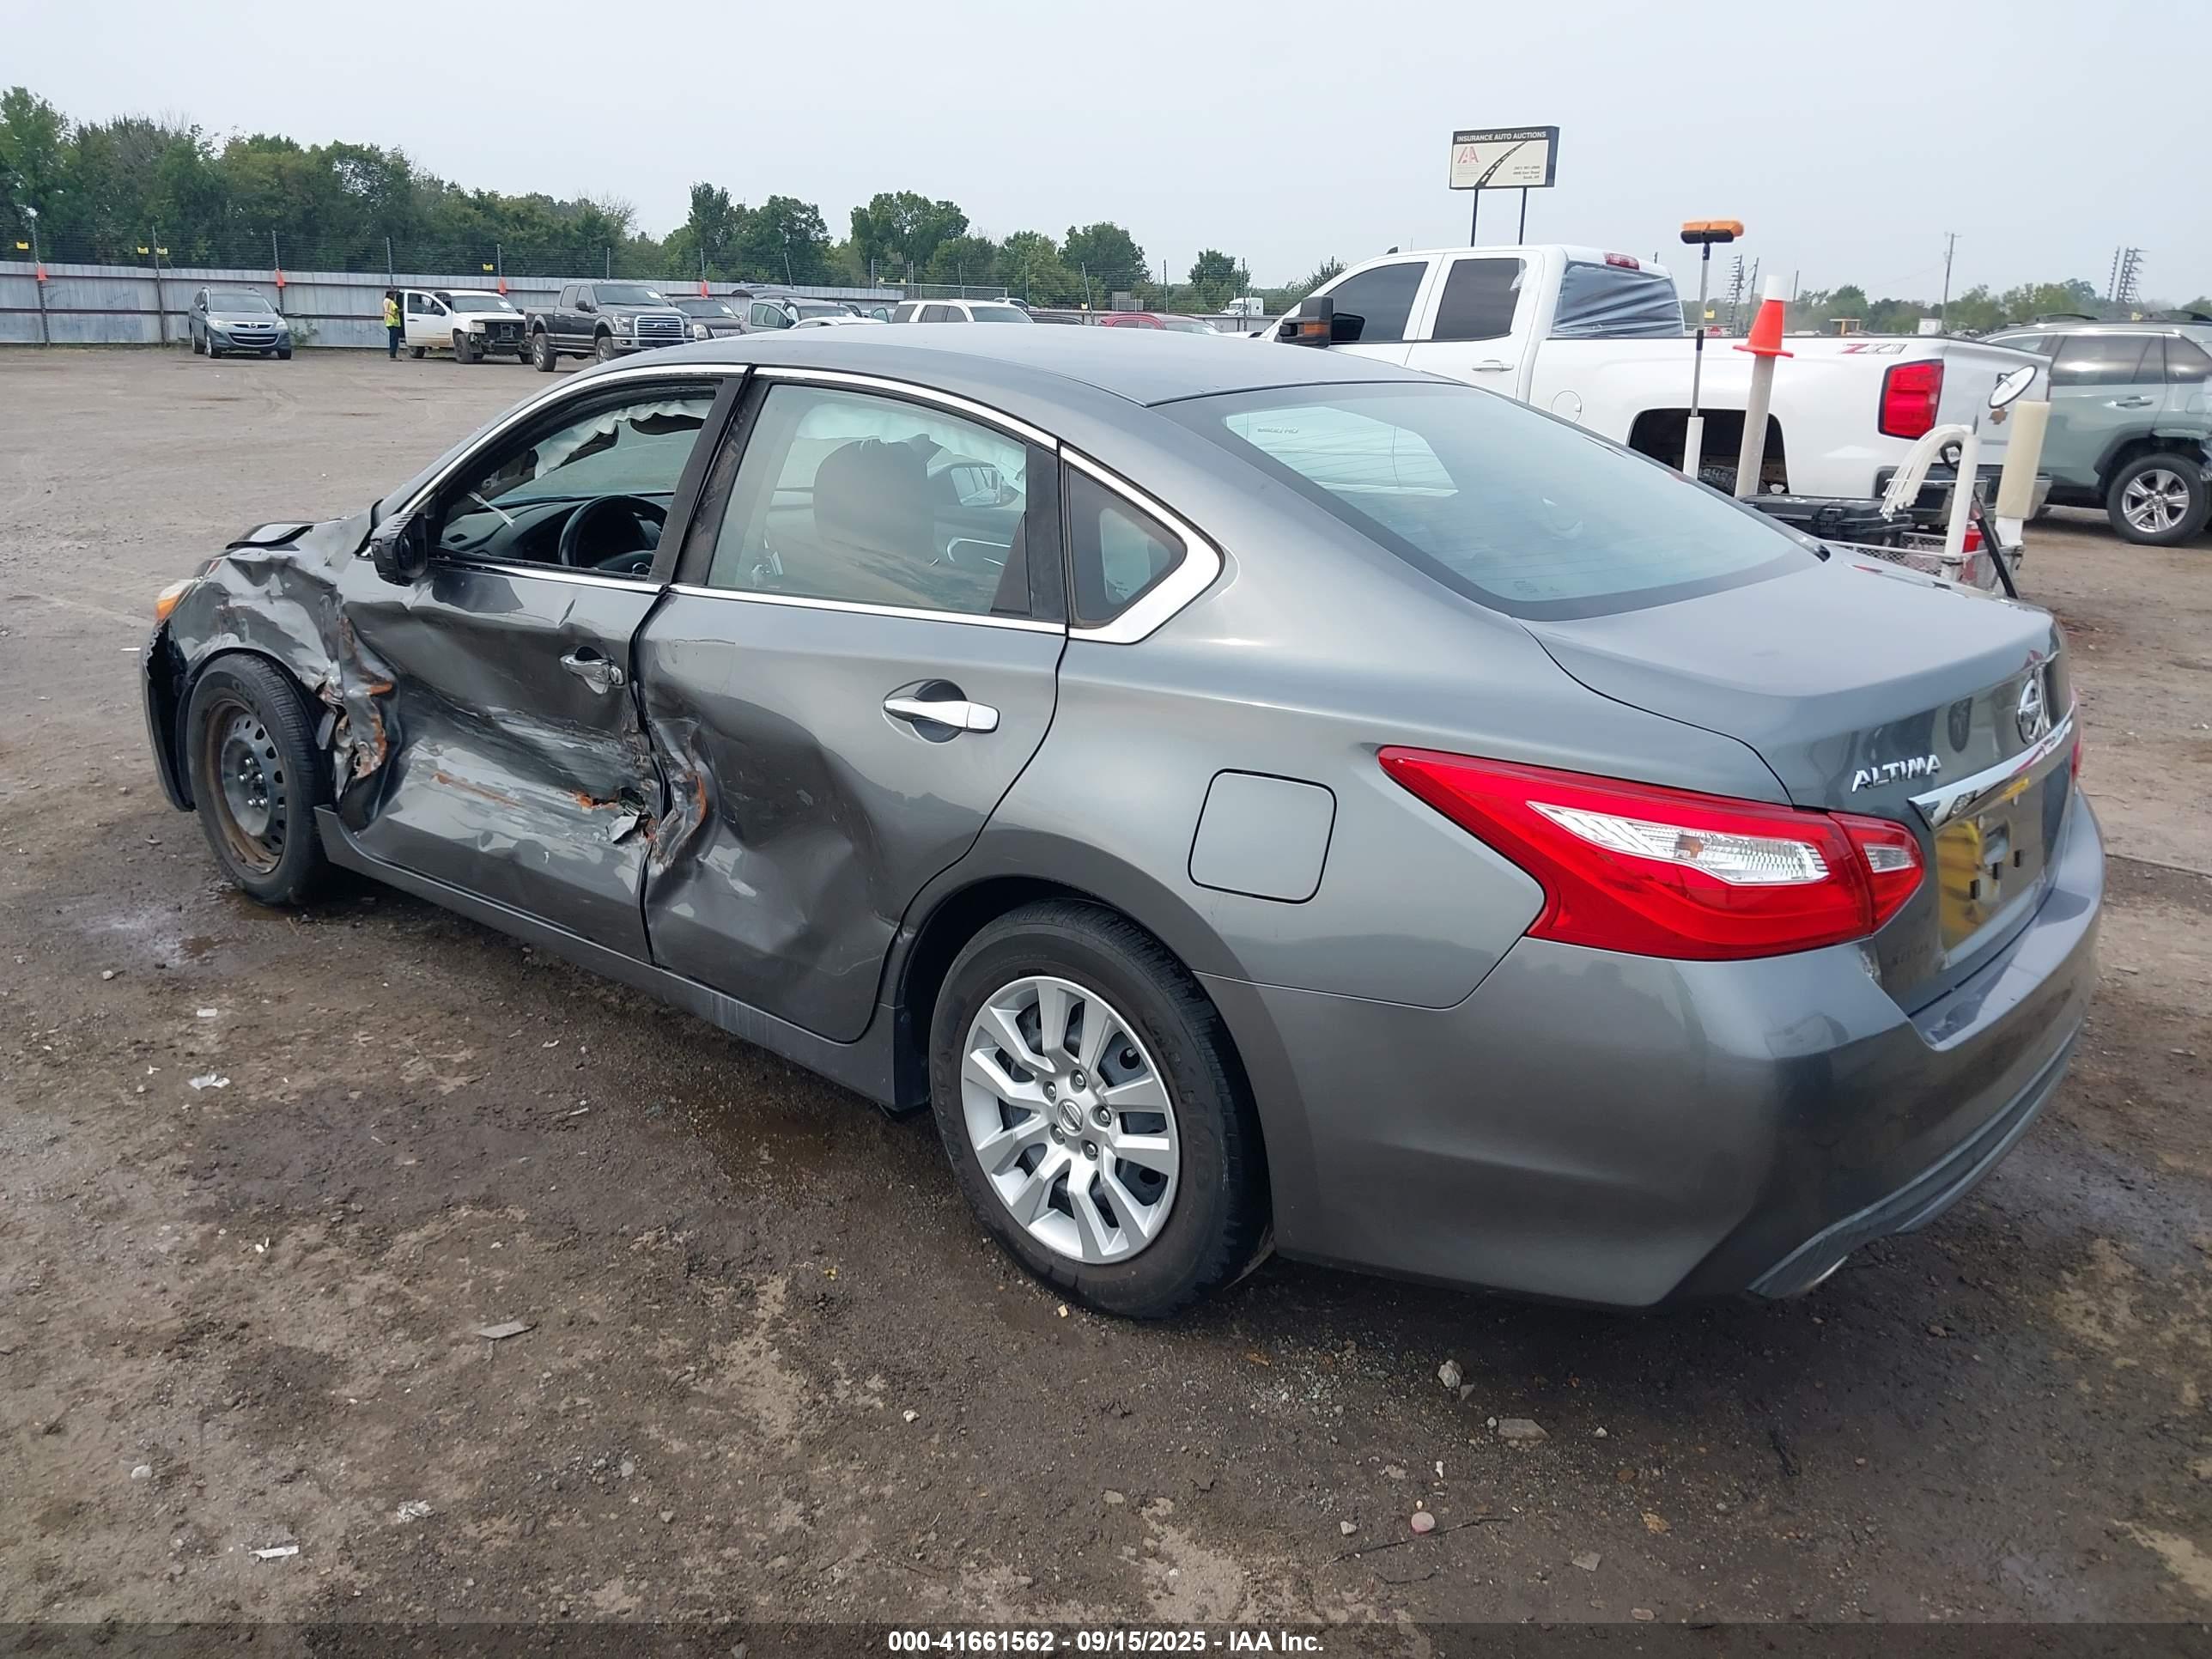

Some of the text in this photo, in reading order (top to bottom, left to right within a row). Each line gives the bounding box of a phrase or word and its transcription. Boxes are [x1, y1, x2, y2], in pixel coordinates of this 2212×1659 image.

[1456, 131, 1547, 143] INSURANCE AUTO AUCTIONS
[1851, 754, 1942, 793] ALTIMA
